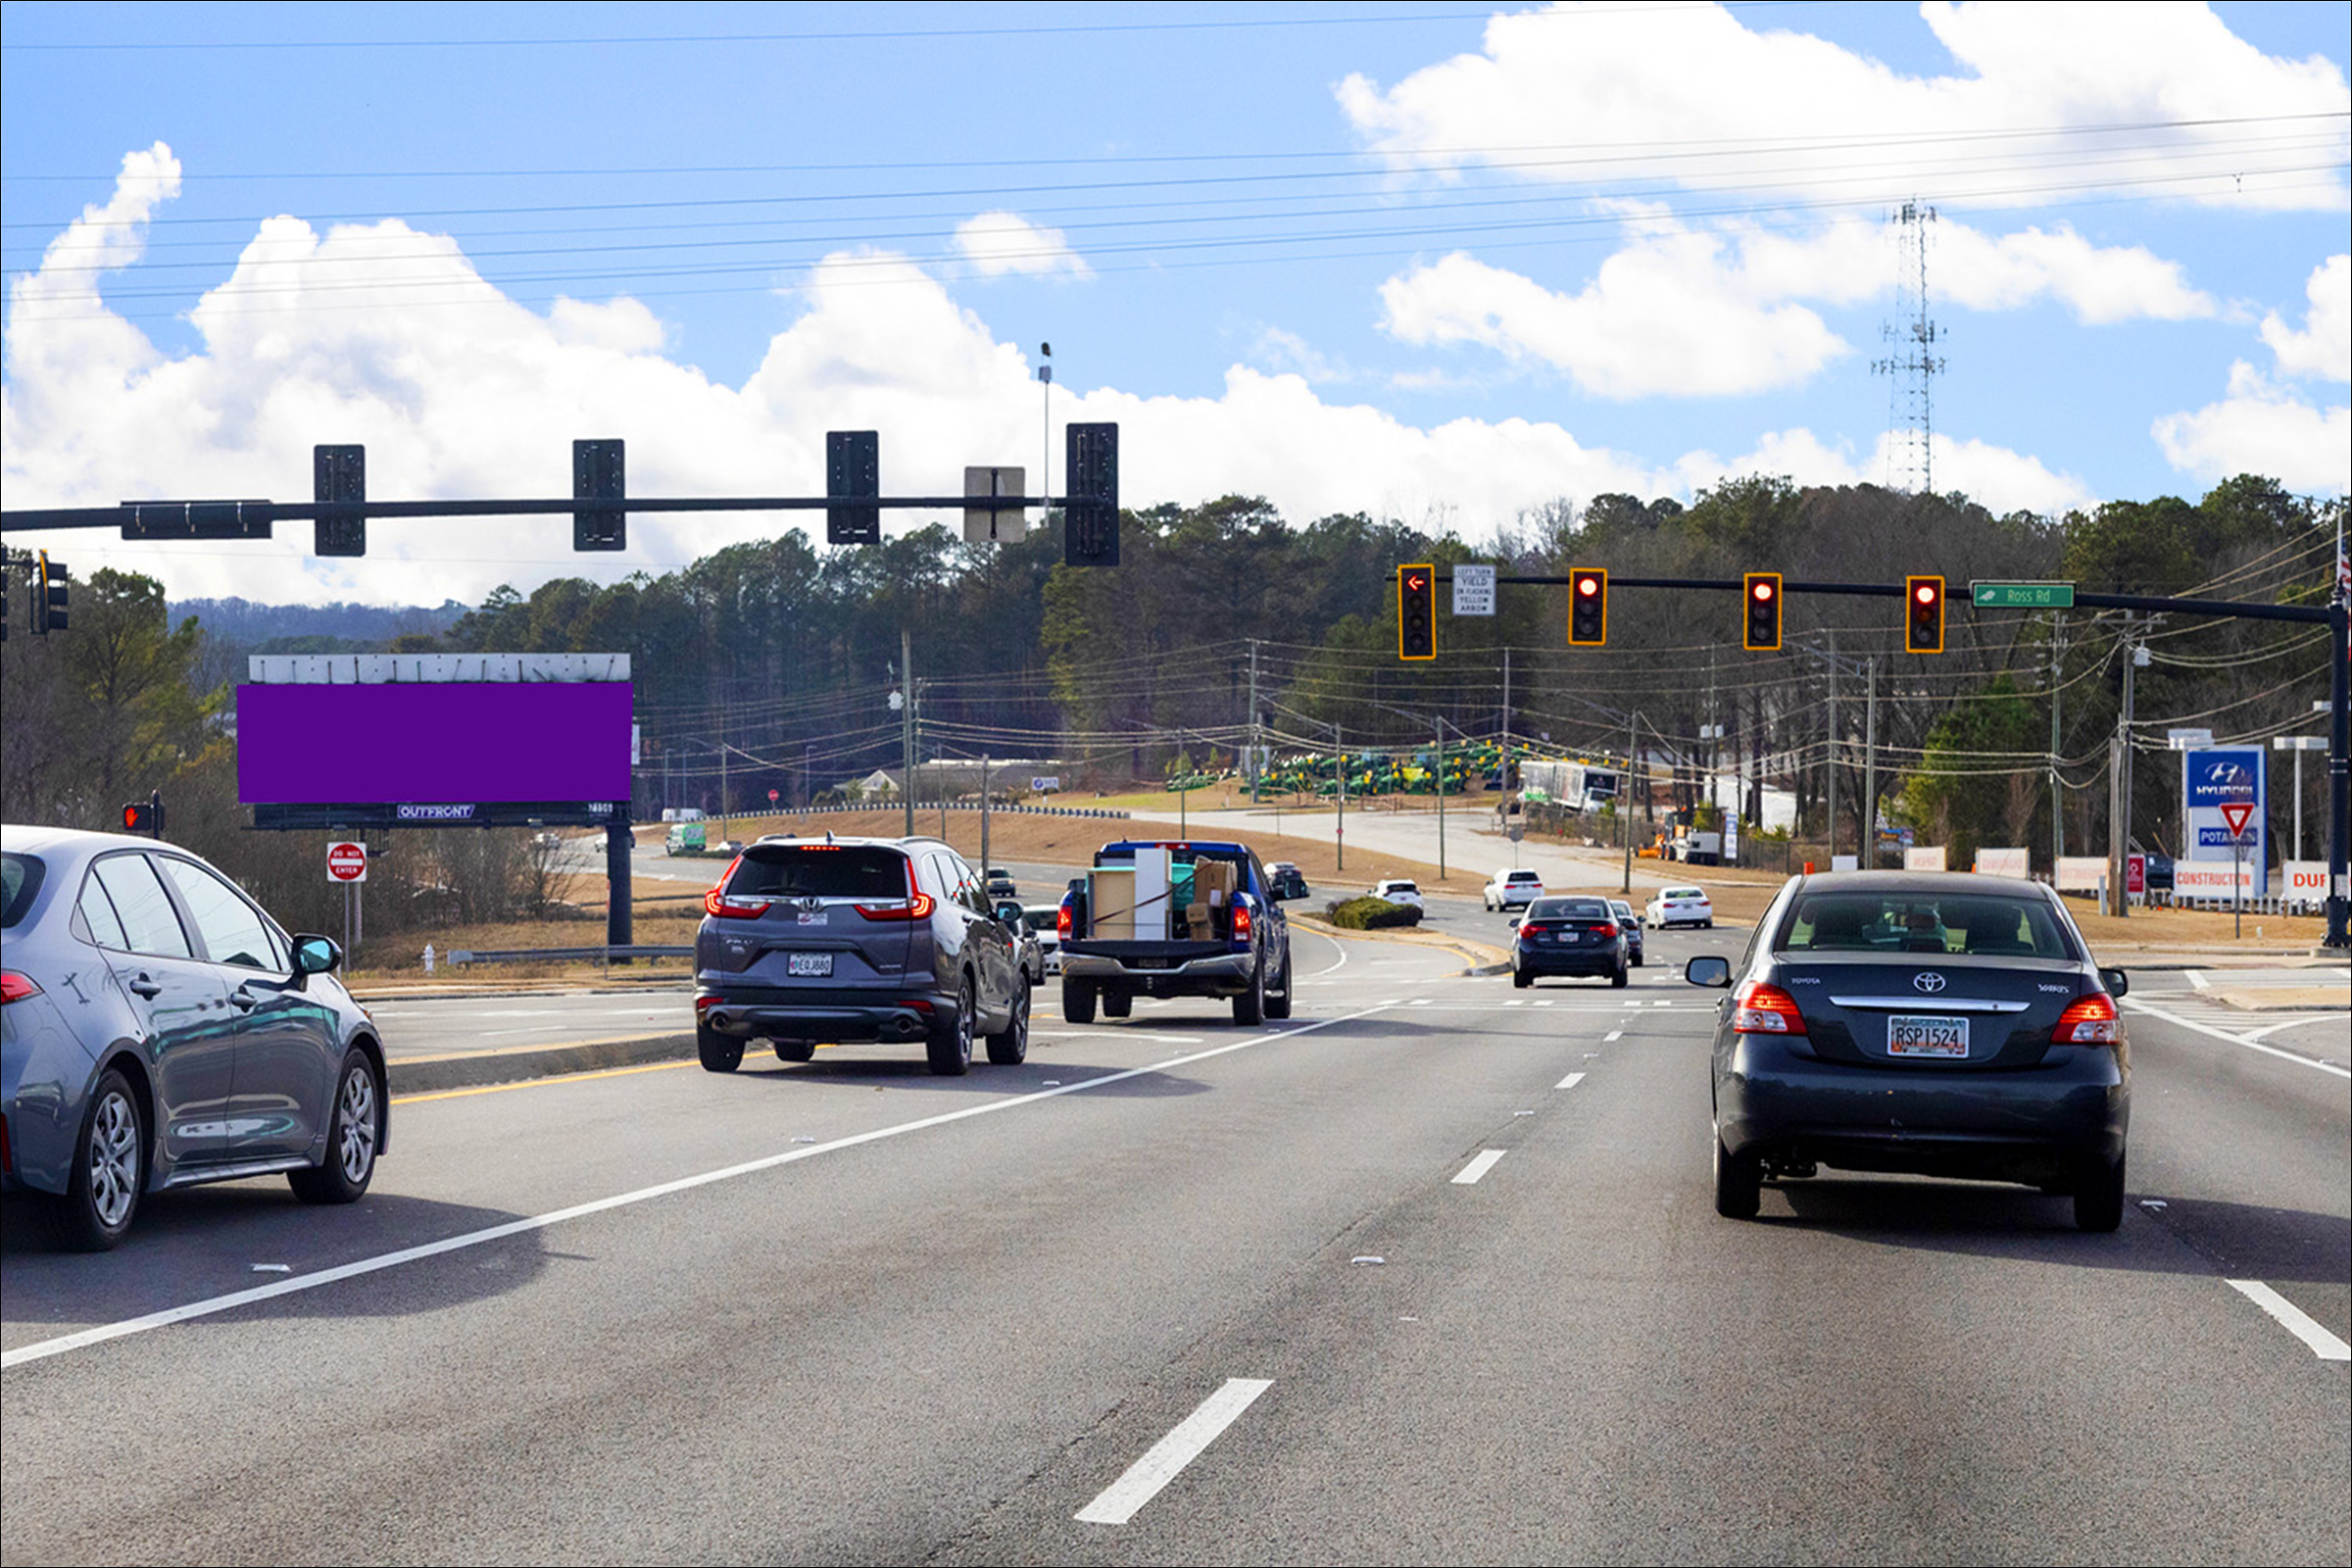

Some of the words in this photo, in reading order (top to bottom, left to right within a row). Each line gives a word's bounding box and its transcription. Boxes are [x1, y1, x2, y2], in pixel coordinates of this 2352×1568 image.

[2008, 589, 2033, 603] Ross
[2036, 589, 2051, 603] Rd
[401, 806, 470, 817] OUTFRONT
[1896, 1027, 1958, 1048] RSP1524
